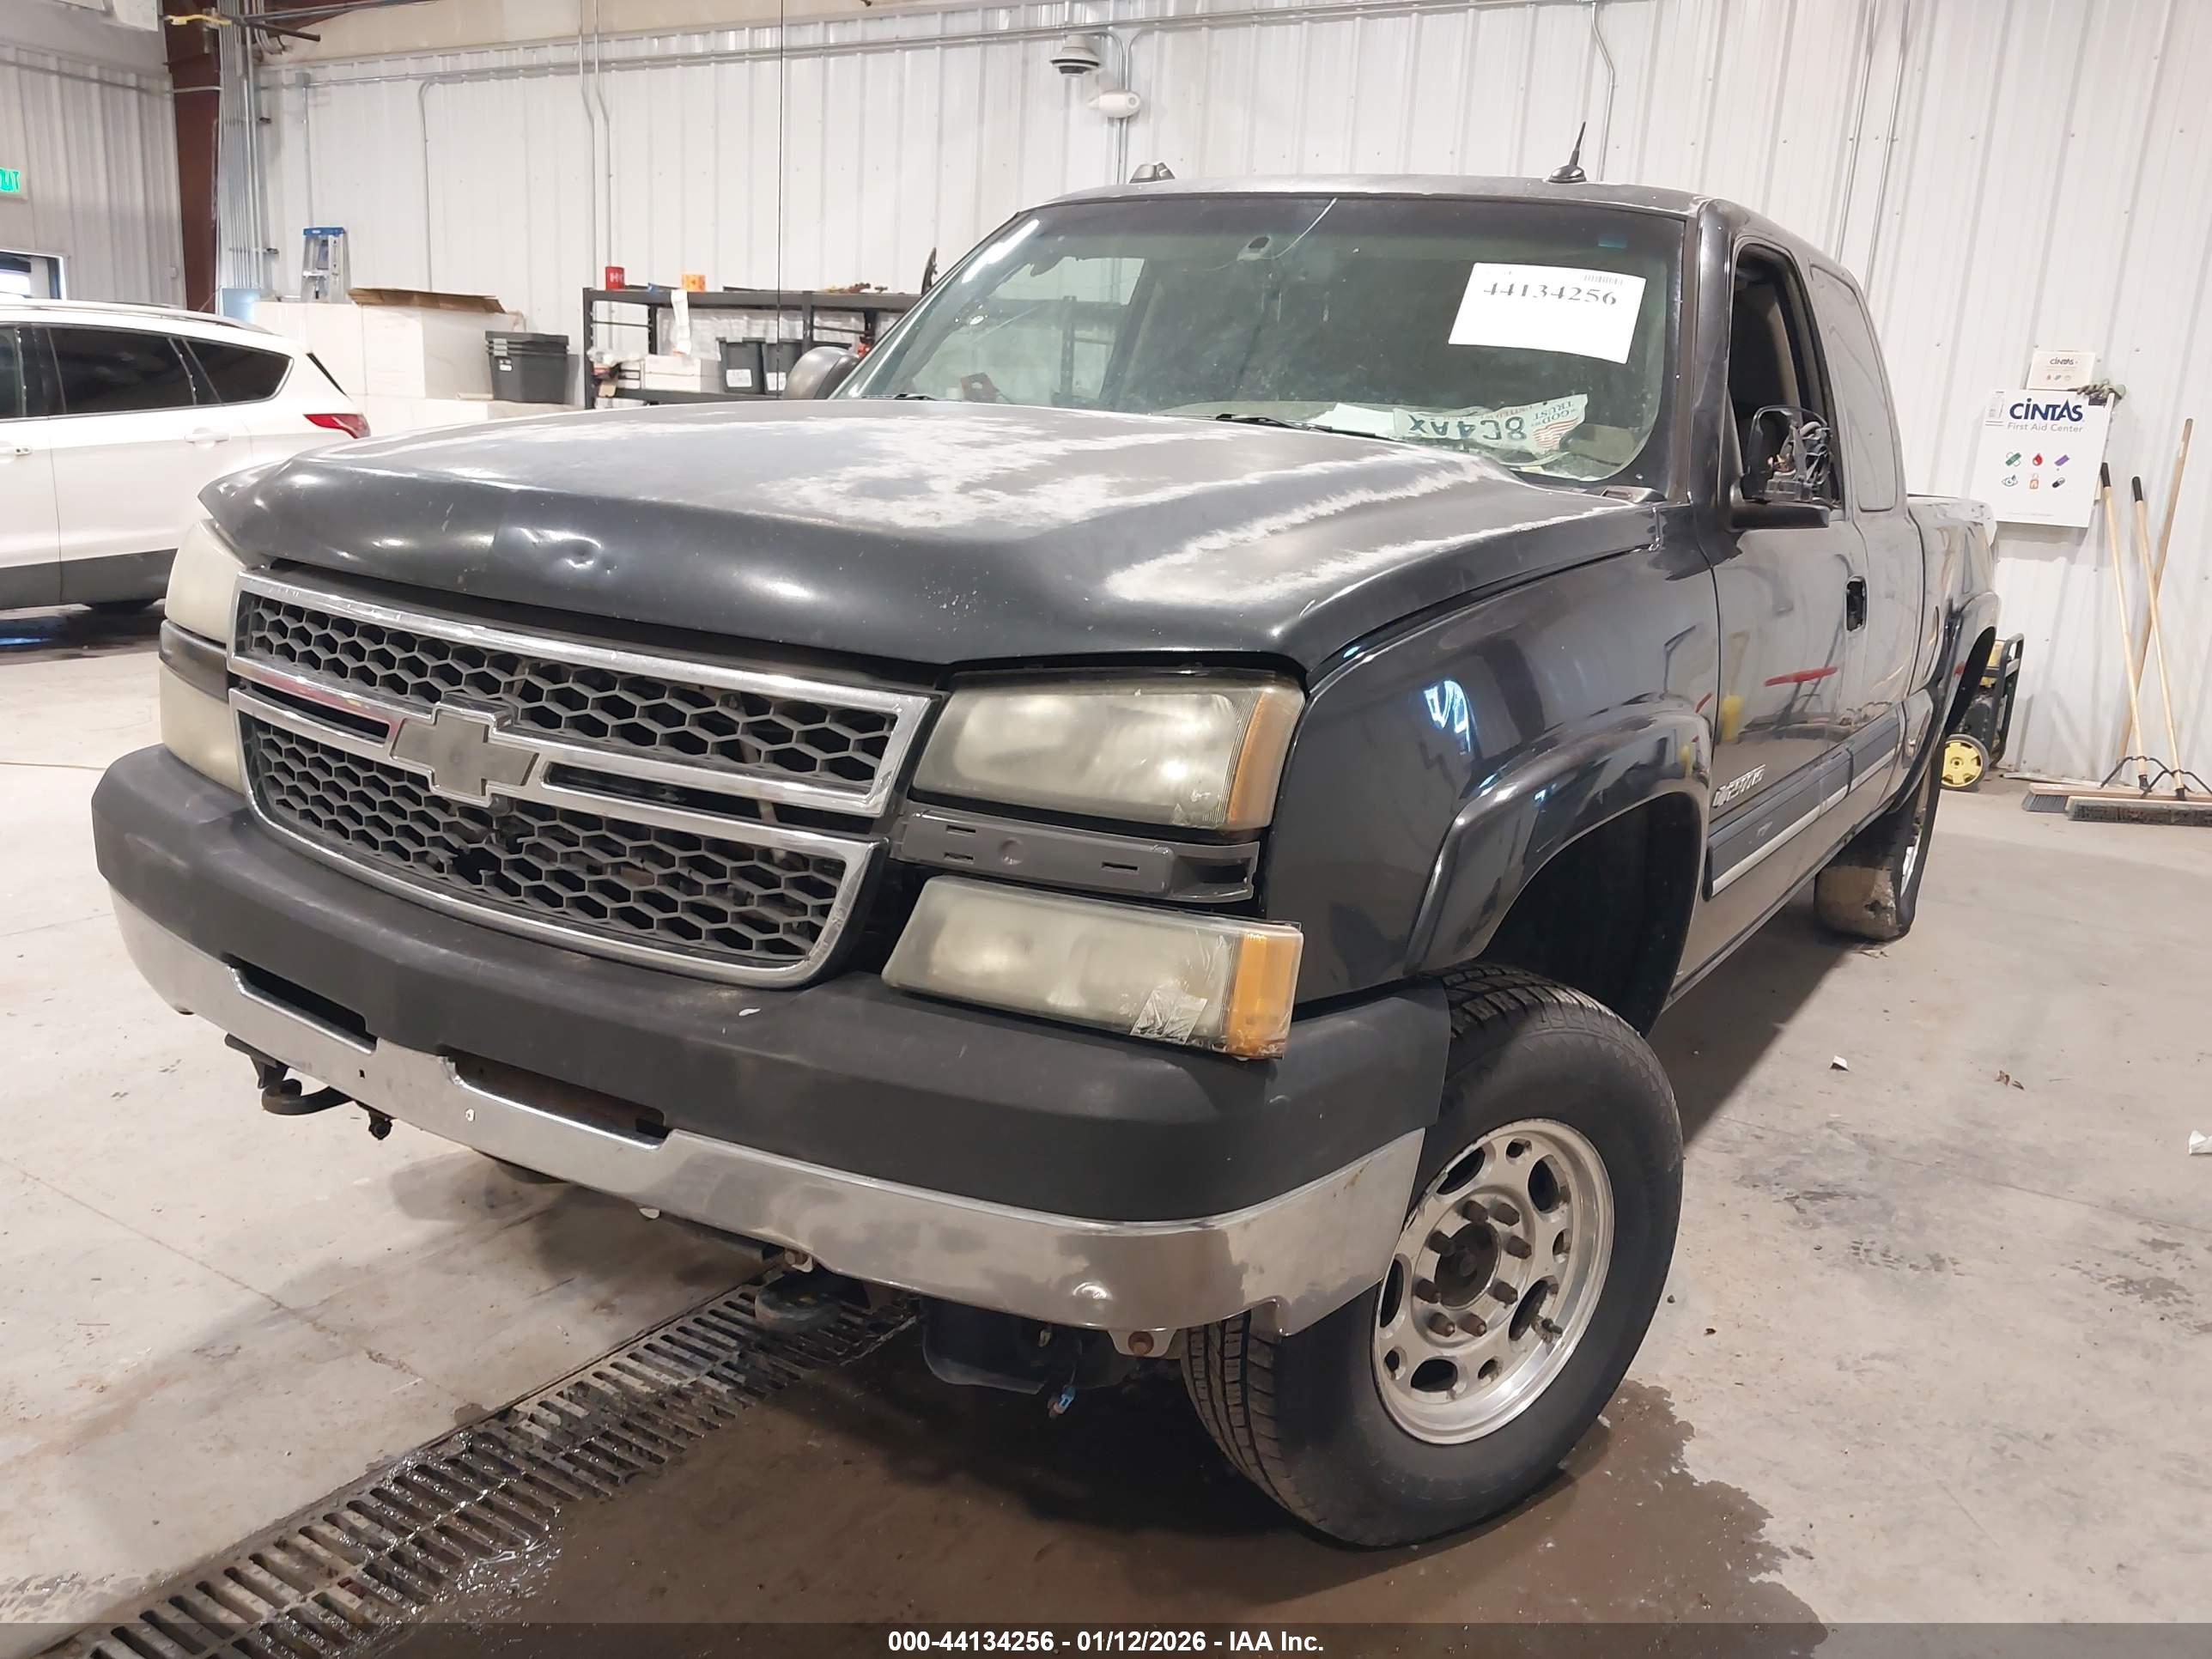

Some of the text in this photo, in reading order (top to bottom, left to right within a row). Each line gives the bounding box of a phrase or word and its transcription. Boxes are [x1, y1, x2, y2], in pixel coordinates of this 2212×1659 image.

[1484, 283, 1617, 305] 44134256
[2009, 398, 2083, 422] CINTAS
[1409, 414, 1527, 440] 8C4AX
[2007, 422, 2028, 431] First
[2051, 423, 2084, 433] Center
